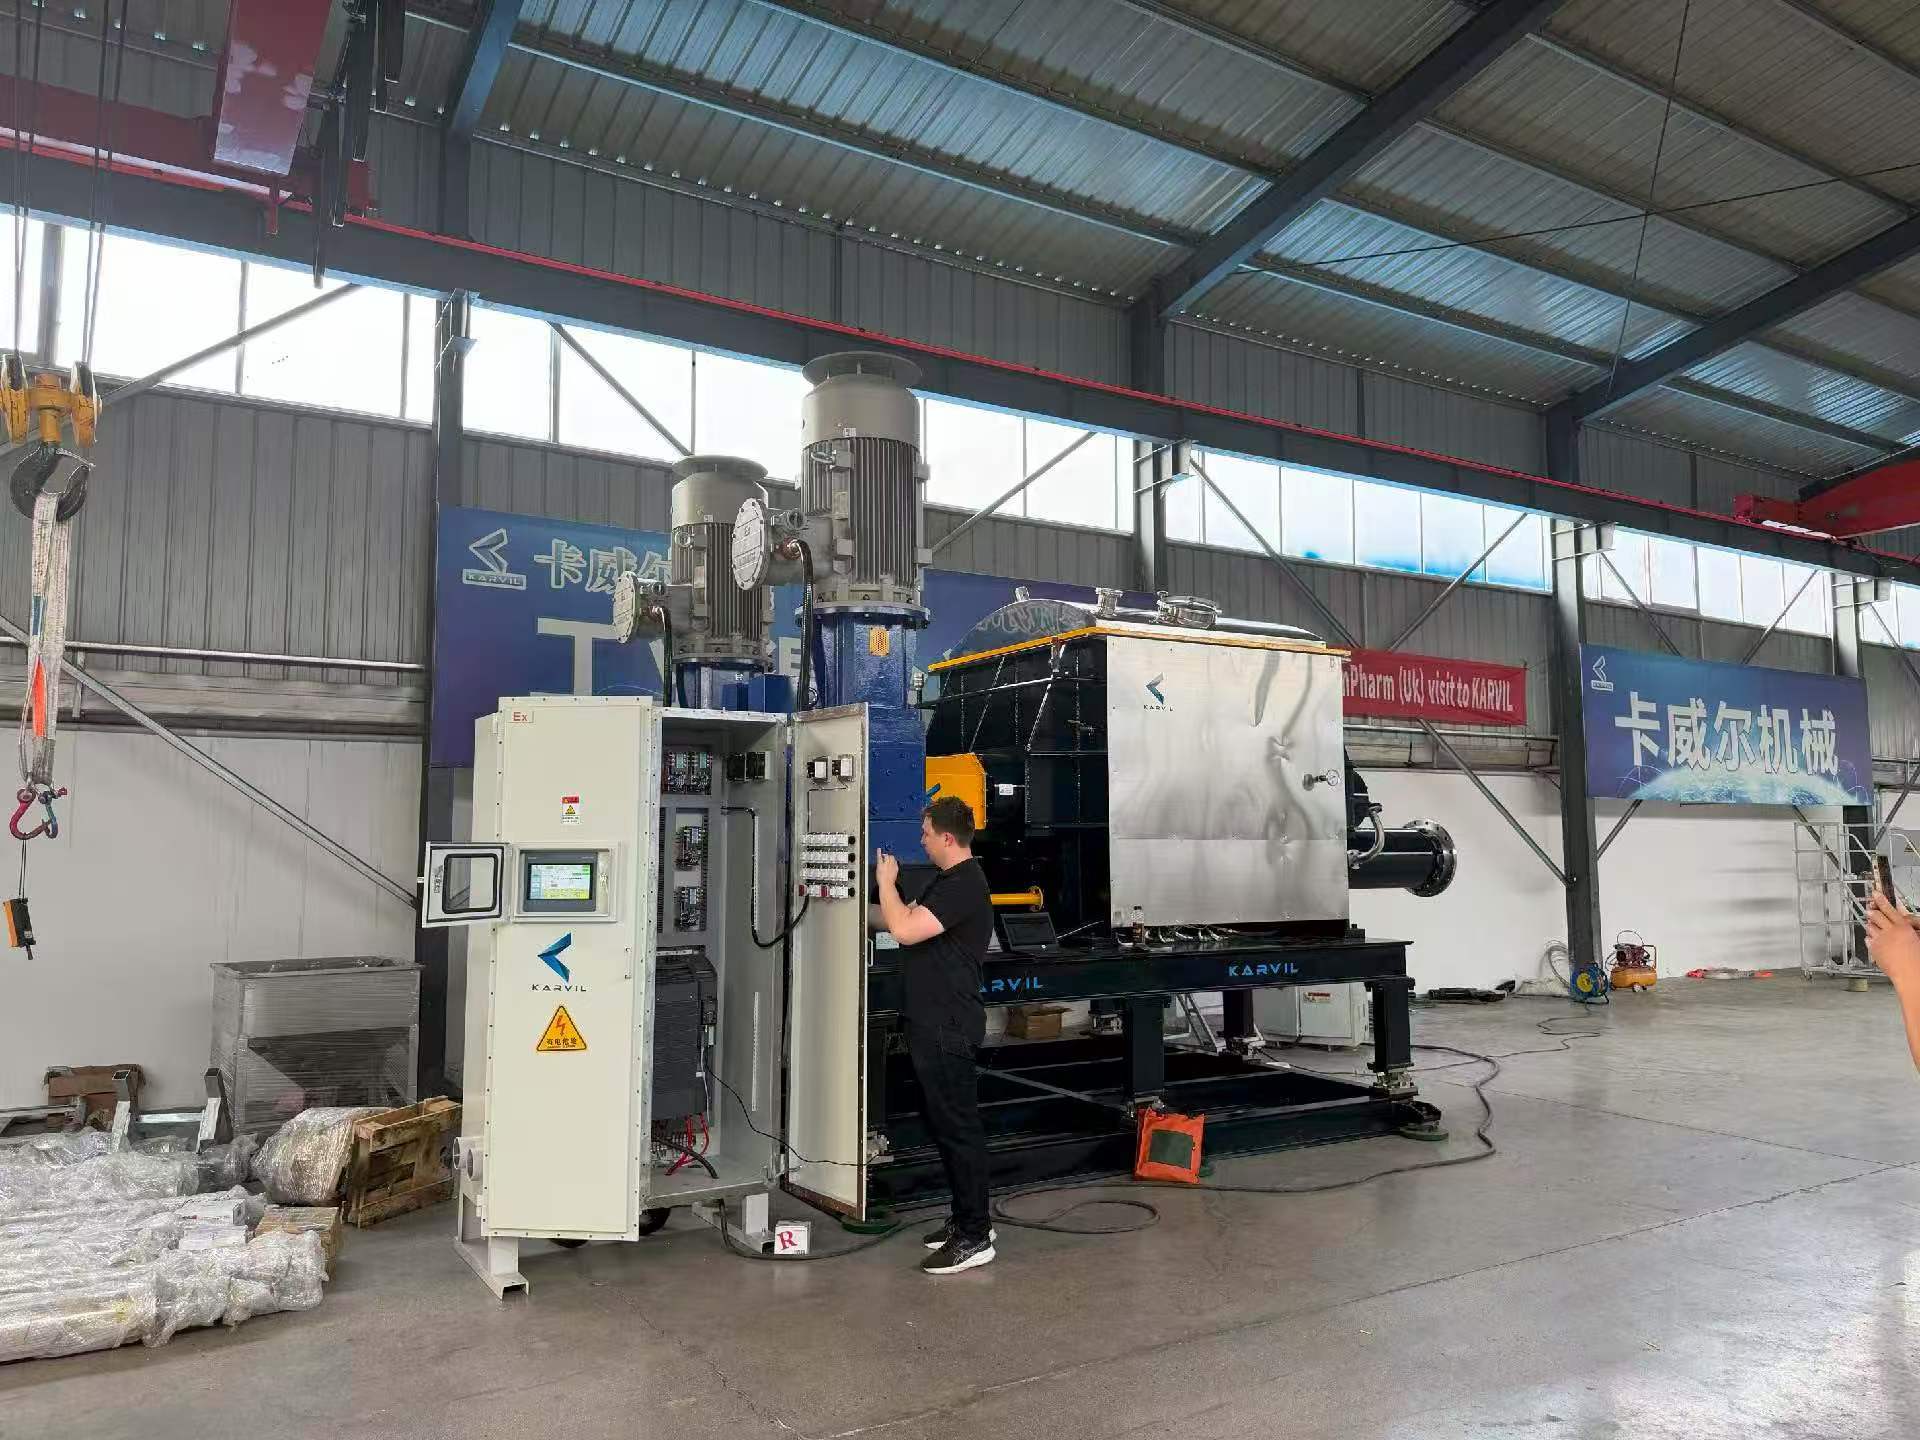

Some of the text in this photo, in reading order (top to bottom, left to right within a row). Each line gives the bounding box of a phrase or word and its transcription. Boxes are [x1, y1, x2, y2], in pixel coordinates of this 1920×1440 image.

[468, 574, 521, 585] KARVIL
[1399, 666, 1424, 707] (Uk)
[1428, 669, 1455, 707] visit
[1456, 681, 1470, 708] to
[1471, 677, 1514, 712] KARVIL
[1143, 704, 1174, 712] KARVL
[513, 711, 528, 722] Ex
[1614, 691, 1839, 776] 卡威尔机械
[1228, 962, 1299, 977] KARVIL
[531, 984, 587, 992] KARVIL
